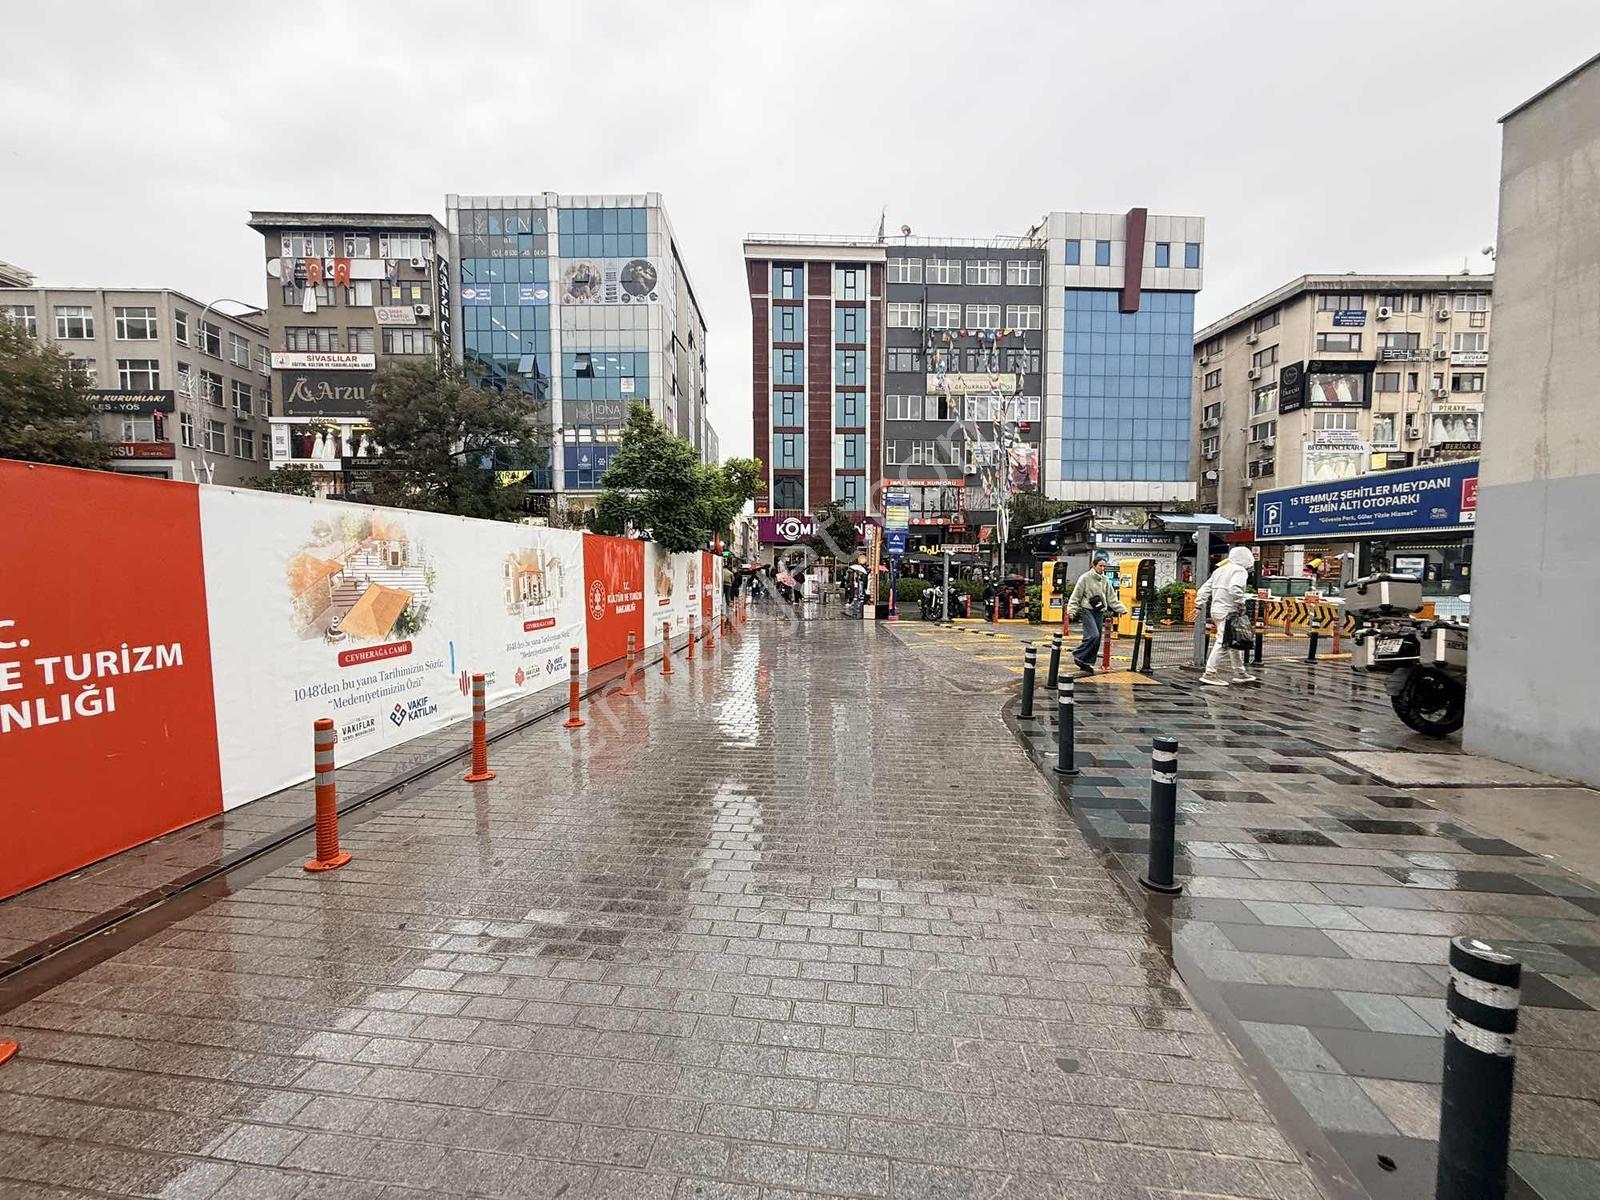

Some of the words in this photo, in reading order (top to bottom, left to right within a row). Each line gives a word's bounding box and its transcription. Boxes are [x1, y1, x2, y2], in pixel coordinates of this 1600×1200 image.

[316, 382, 365, 400] Arzu
[1290, 497, 1299, 506] 15
[1299, 491, 1342, 505] TEMMUZ
[1341, 485, 1390, 501] ŞEHİTLER
[1392, 477, 1451, 495] MEYDANI
[1308, 501, 1339, 514] ZEMİN
[1340, 499, 1361, 510] ALTI
[1363, 493, 1420, 509] OTOPARKI
[1269, 509, 1277, 524] P
[35, 642, 184, 685] TURİZM
[345, 647, 388, 663] CEVHERAĞA
[294, 682, 340, 702] 1048'den
[342, 679, 355, 690] bu
[355, 674, 378, 691] yana
[378, 664, 424, 682] Tarihimizin
[407, 696, 428, 710] VAKIF
[408, 704, 438, 722] KATILIM
[341, 718, 375, 736] VAKIFLAR
